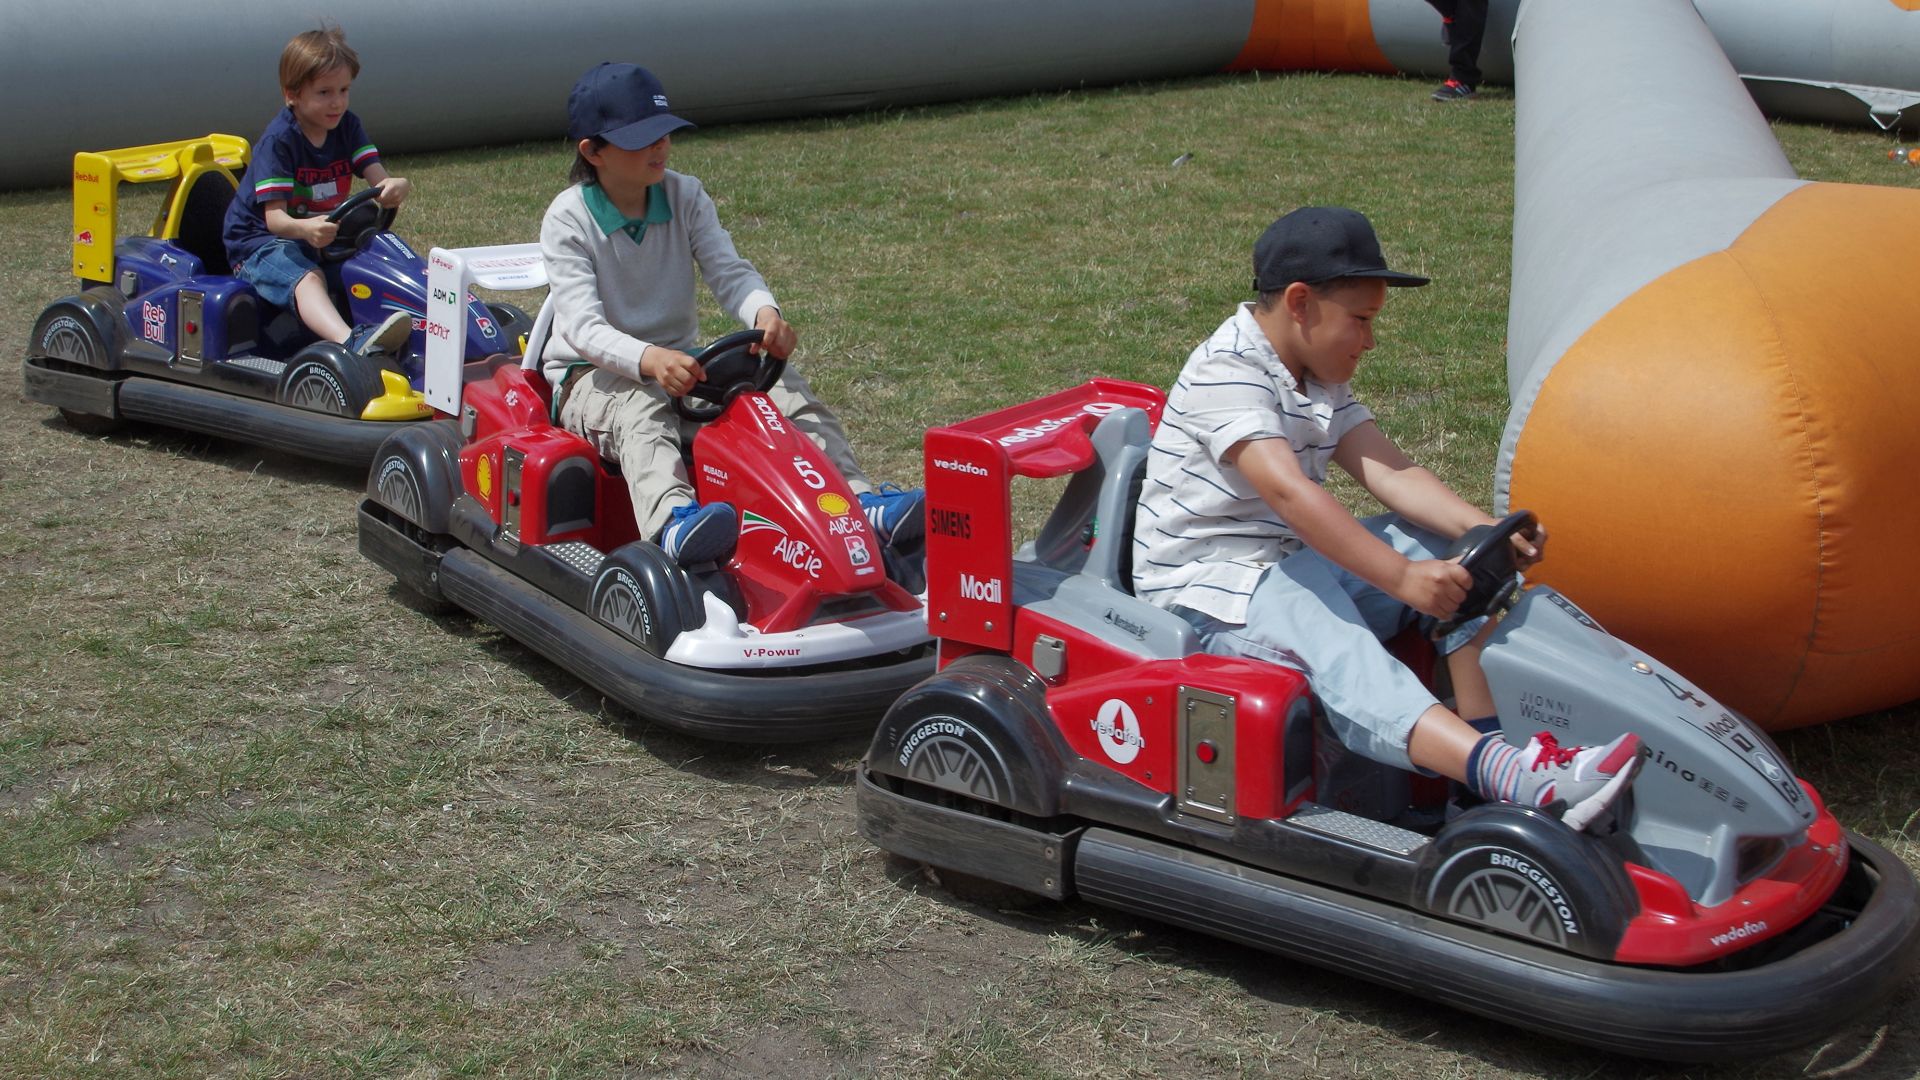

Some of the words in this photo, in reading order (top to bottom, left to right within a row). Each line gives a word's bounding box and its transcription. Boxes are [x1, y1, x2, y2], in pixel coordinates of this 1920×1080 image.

[433, 287, 447, 302] ADM
[143, 300, 167, 325] Reb
[144, 320, 165, 344] Bull
[309, 366, 346, 407] BRIGGESTON
[792, 459, 826, 490] 5
[933, 458, 988, 477] vedafon
[931, 507, 972, 540] SIMENS
[617, 571, 651, 635] BRIGGESTON
[960, 573, 1002, 604] Modil
[743, 648, 801, 658] V-Powur
[899, 722, 965, 767] BRIGGESTON
[1089, 717, 1145, 749] vedafon
[1490, 852, 1578, 935] BRIGGESTON
[1709, 919, 1768, 948] vedafon
